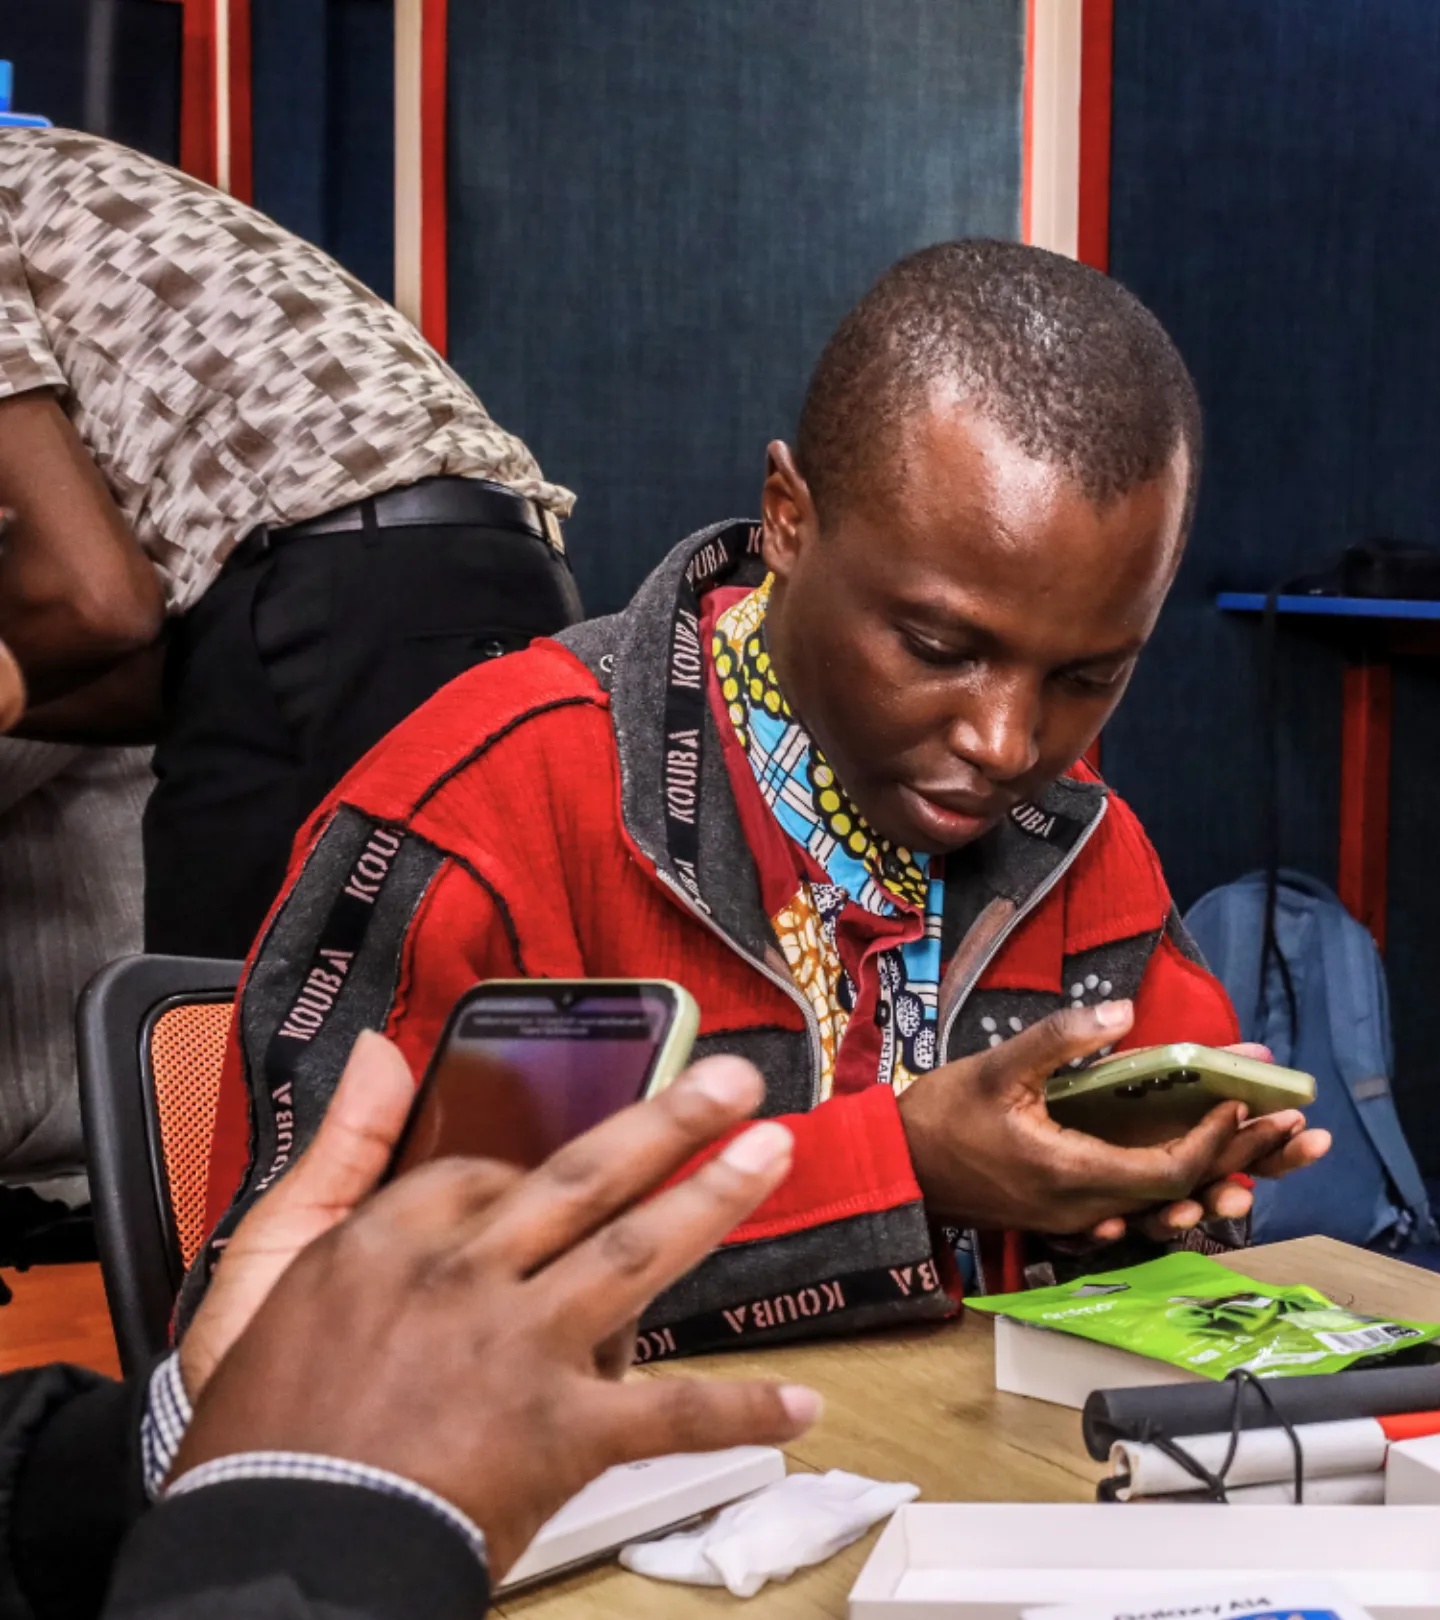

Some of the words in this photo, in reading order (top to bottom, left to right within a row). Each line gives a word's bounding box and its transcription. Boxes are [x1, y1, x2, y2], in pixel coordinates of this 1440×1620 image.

[671, 607, 701, 690] KOUBA
[666, 729, 700, 824] KOUBA
[1011, 803, 1057, 838] UBA
[344, 827, 405, 904] KOU
[277, 948, 355, 1041] KOUBA
[722, 1281, 847, 1334] KOUBA
